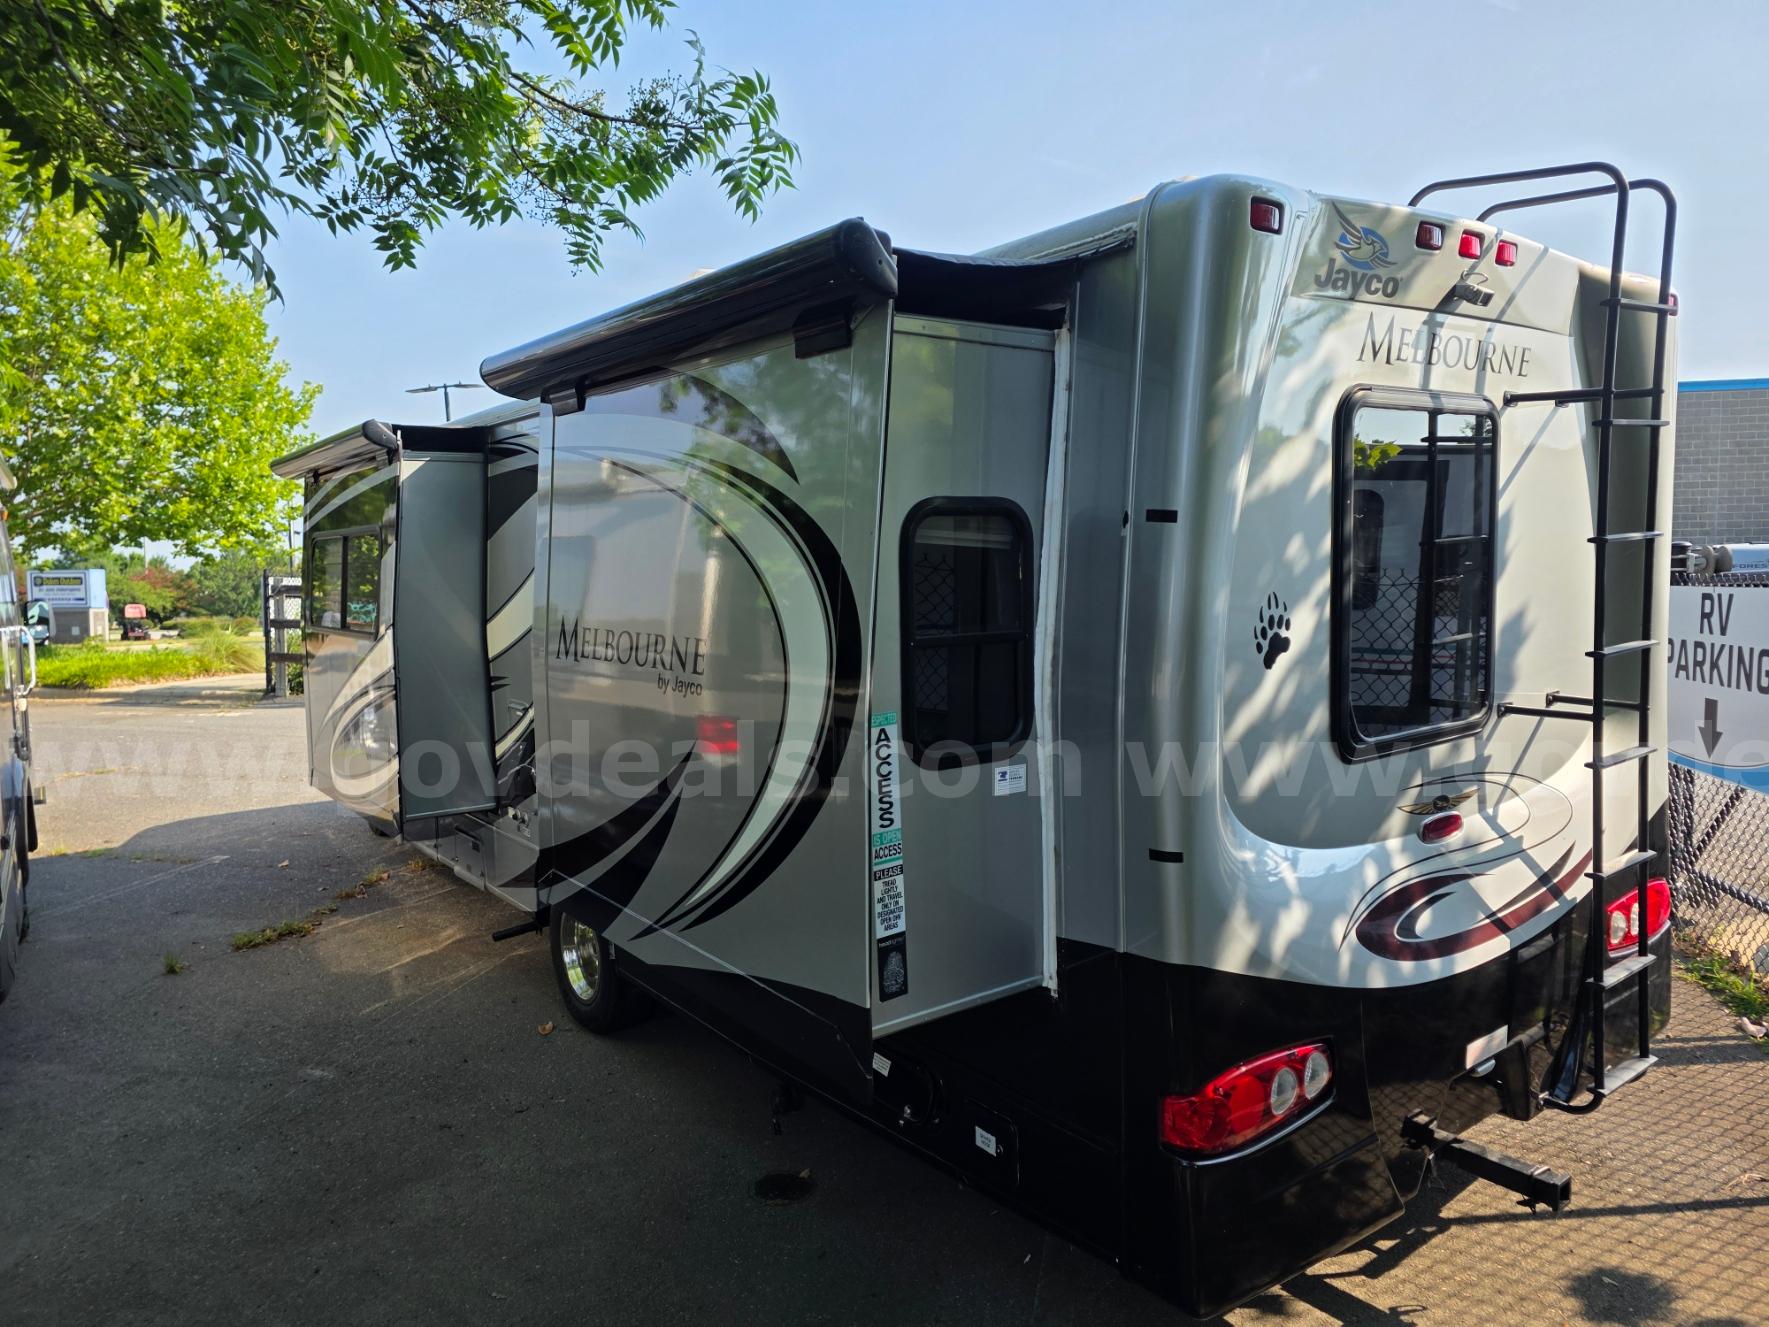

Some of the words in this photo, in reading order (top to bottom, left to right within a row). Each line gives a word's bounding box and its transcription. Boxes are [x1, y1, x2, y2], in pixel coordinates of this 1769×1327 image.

[1314, 258, 1399, 298] Jayco
[1356, 311, 1532, 377] MELBOURNE
[1700, 592, 1734, 636] RV
[555, 615, 707, 676] MELBOURNE
[657, 673, 671, 693] by
[672, 676, 703, 697] Jayco
[875, 727, 895, 829] ACCESS
[882, 830, 901, 844] OPEN
[874, 842, 902, 860] ACCESS
[875, 865, 902, 881] PLEASE
[882, 878, 897, 888] TREAD
[887, 892, 903, 902] TRAVEL
